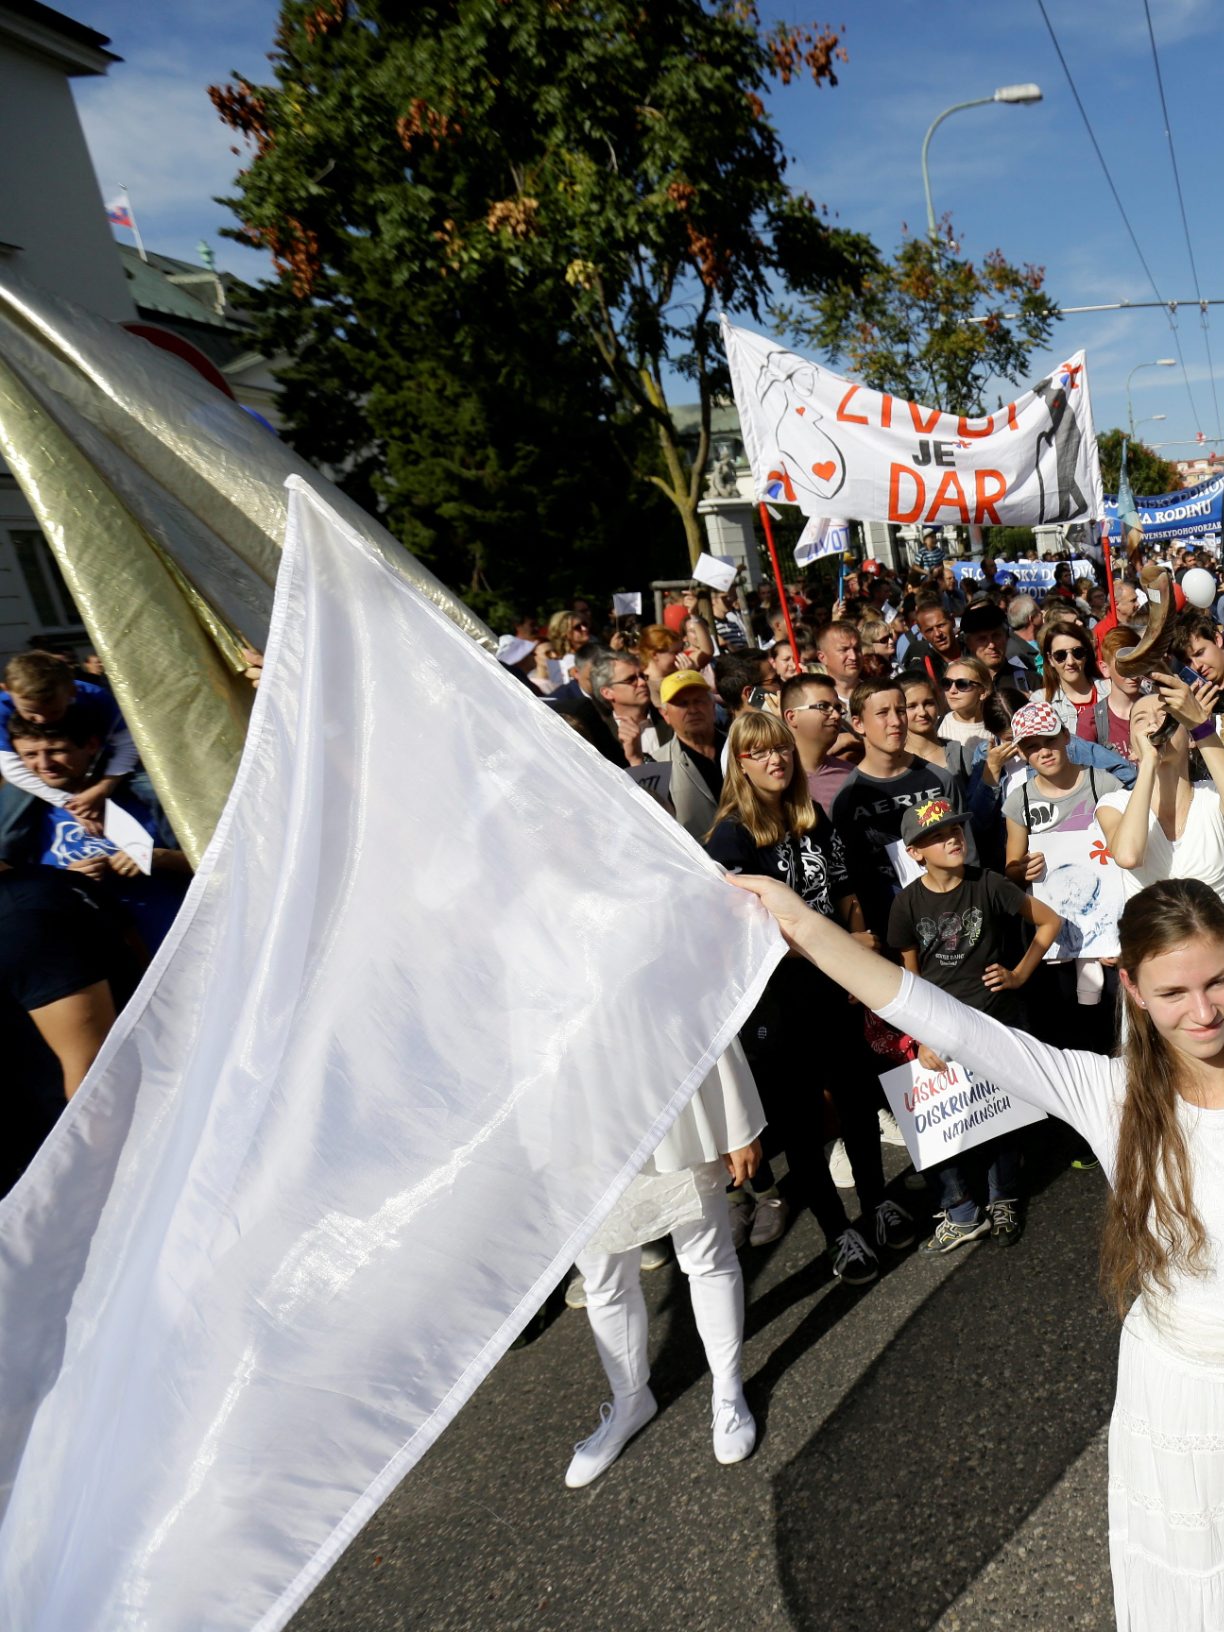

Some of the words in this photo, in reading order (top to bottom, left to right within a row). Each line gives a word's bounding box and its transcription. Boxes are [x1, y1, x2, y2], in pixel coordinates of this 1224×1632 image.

[912, 440, 956, 467] JE
[888, 462, 1007, 525] DAR
[1155, 500, 1212, 524] RODINU
[904, 1067, 959, 1112] LÁSKOU
[943, 1096, 1011, 1142] NAJMENŠÍCH
